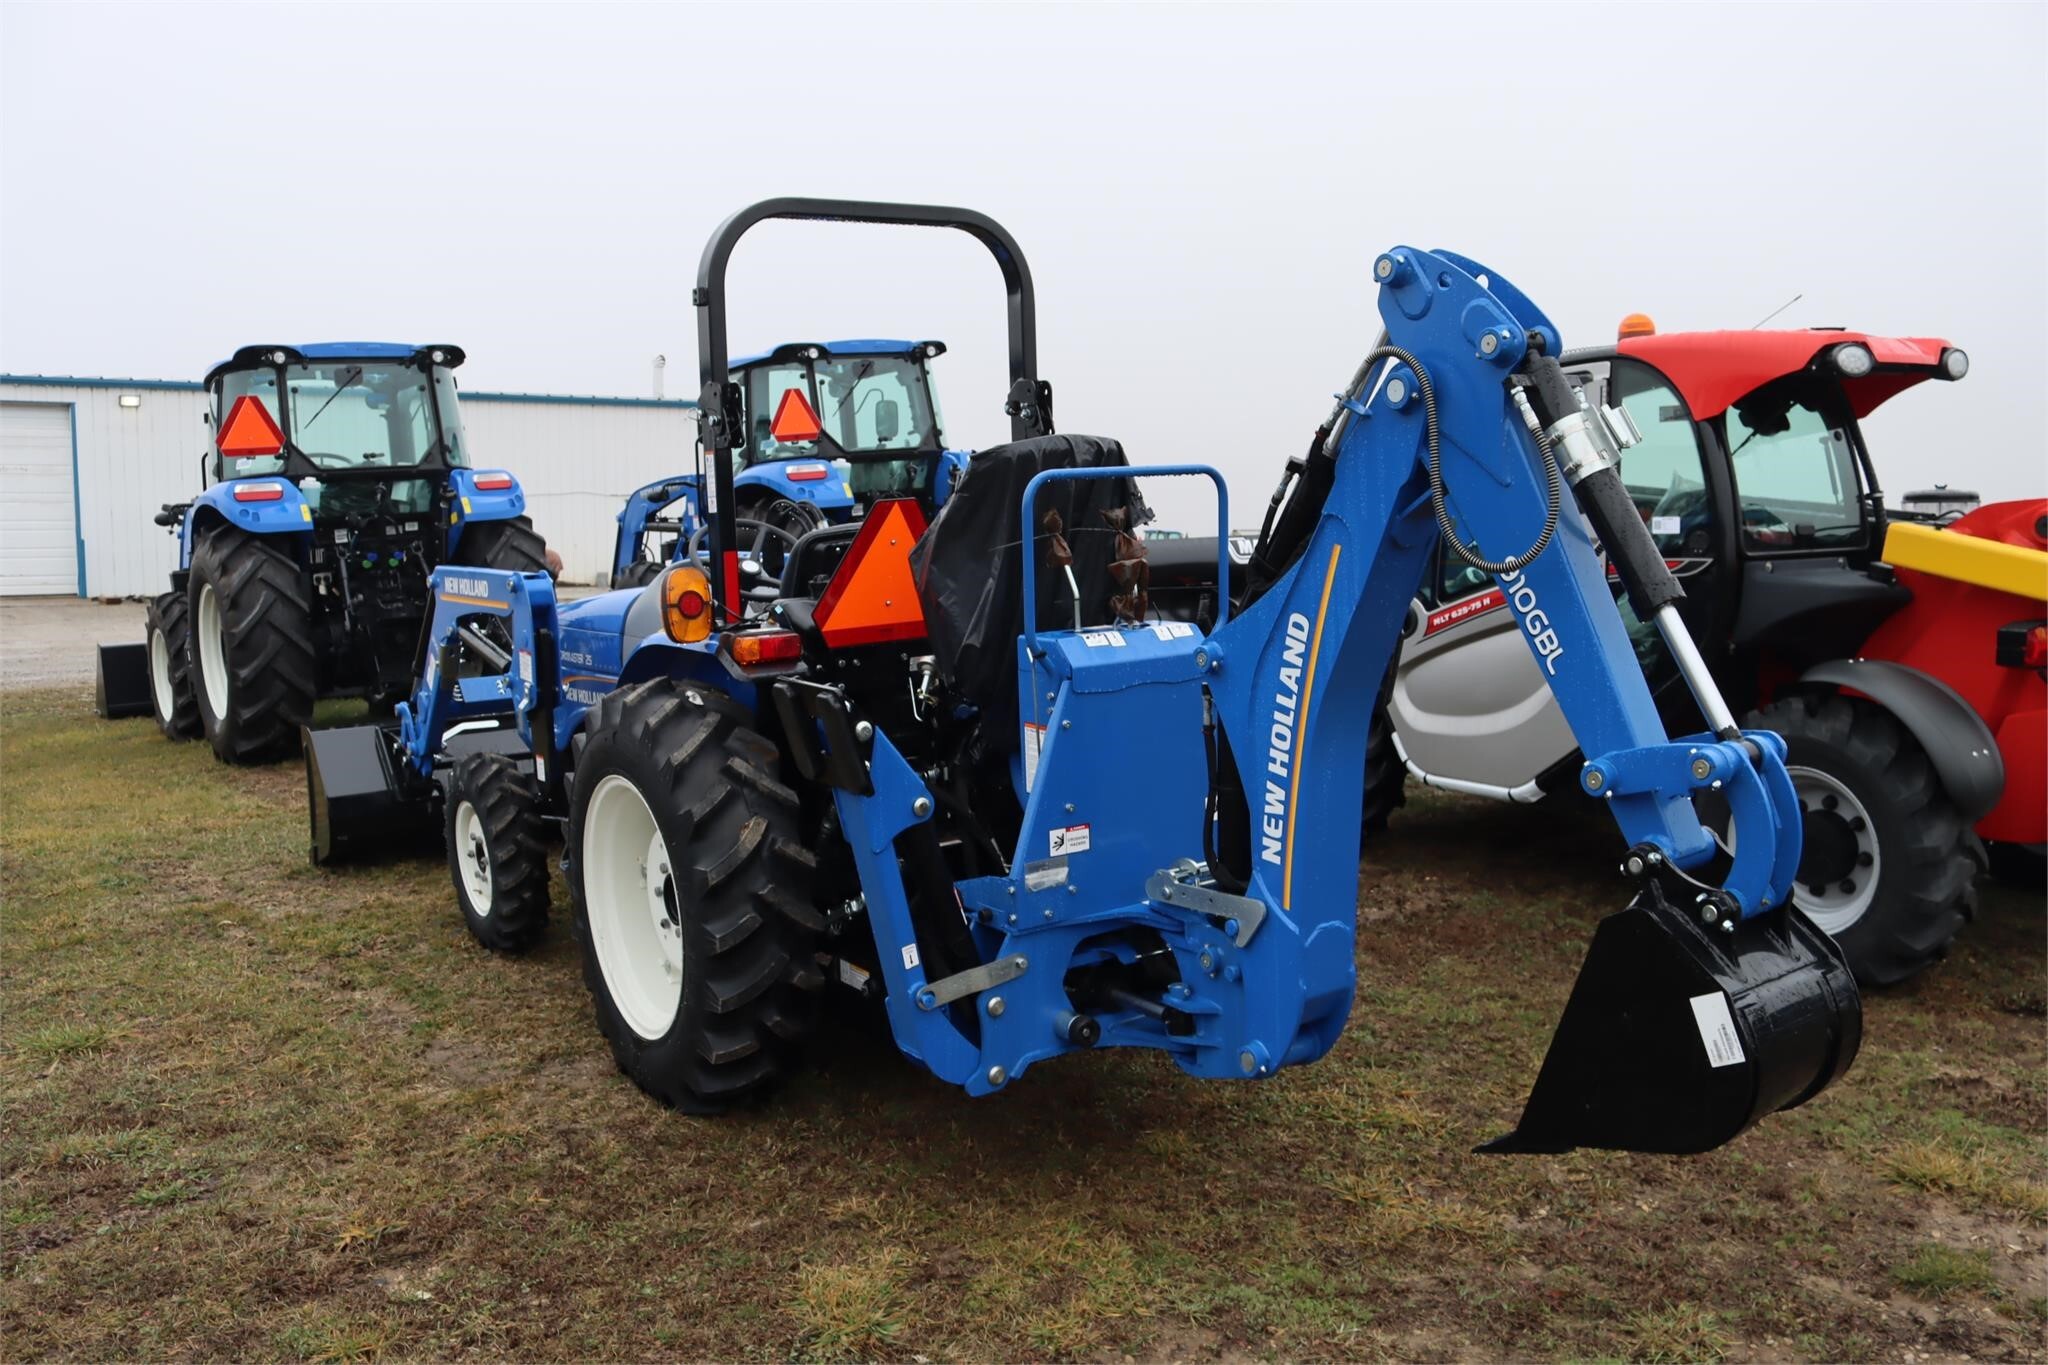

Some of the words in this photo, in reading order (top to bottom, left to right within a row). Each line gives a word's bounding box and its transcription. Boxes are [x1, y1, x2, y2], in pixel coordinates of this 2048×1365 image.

[444, 576, 459, 593] NEW
[460, 579, 488, 598] HOLLAND
[1268, 612, 1310, 778] HOLLAND
[1262, 780, 1286, 865] NEW
